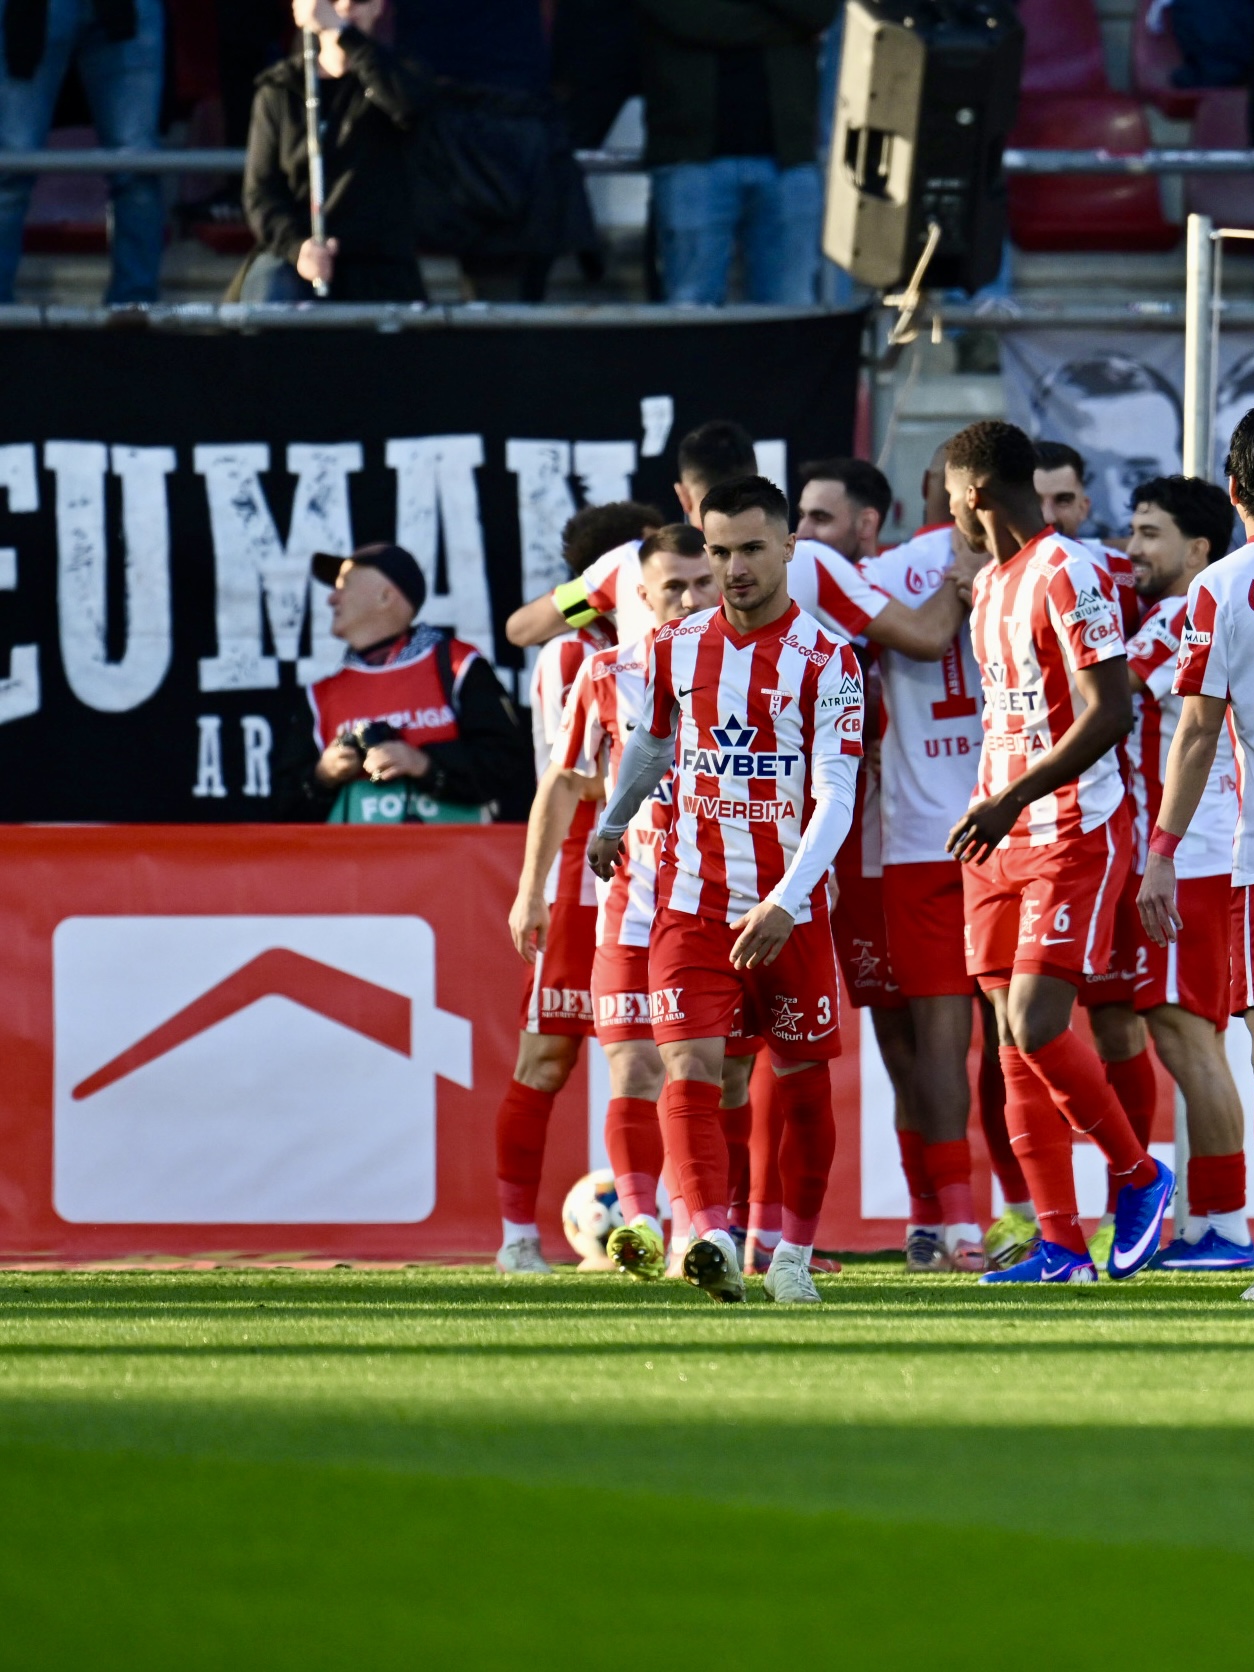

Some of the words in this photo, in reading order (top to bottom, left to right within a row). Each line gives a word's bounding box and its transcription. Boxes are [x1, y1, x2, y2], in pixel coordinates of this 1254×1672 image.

[1066, 600, 1101, 625] TRIUM
[672, 622, 709, 637] cocos
[1184, 632, 1210, 643] MALL
[798, 646, 829, 666] cocos
[1176, 656, 1191, 671] BA
[820, 696, 860, 708] ATRIUM
[985, 690, 1038, 712] VBET
[841, 718, 861, 733] CB
[924, 736, 981, 758] UTB-
[988, 734, 1047, 753] ERBITA
[193, 715, 273, 797] AR
[683, 748, 799, 777] FAVBET
[703, 798, 797, 821] VERBITA
[1053, 904, 1071, 932] 6
[1136, 946, 1148, 974] 2
[542, 986, 593, 1013] DEY
[599, 992, 650, 1019] DEY
[650, 987, 684, 1018] EY
[775, 994, 798, 1004] Pizza
[817, 995, 831, 1025] 3
[664, 1012, 685, 1021] ARAD
